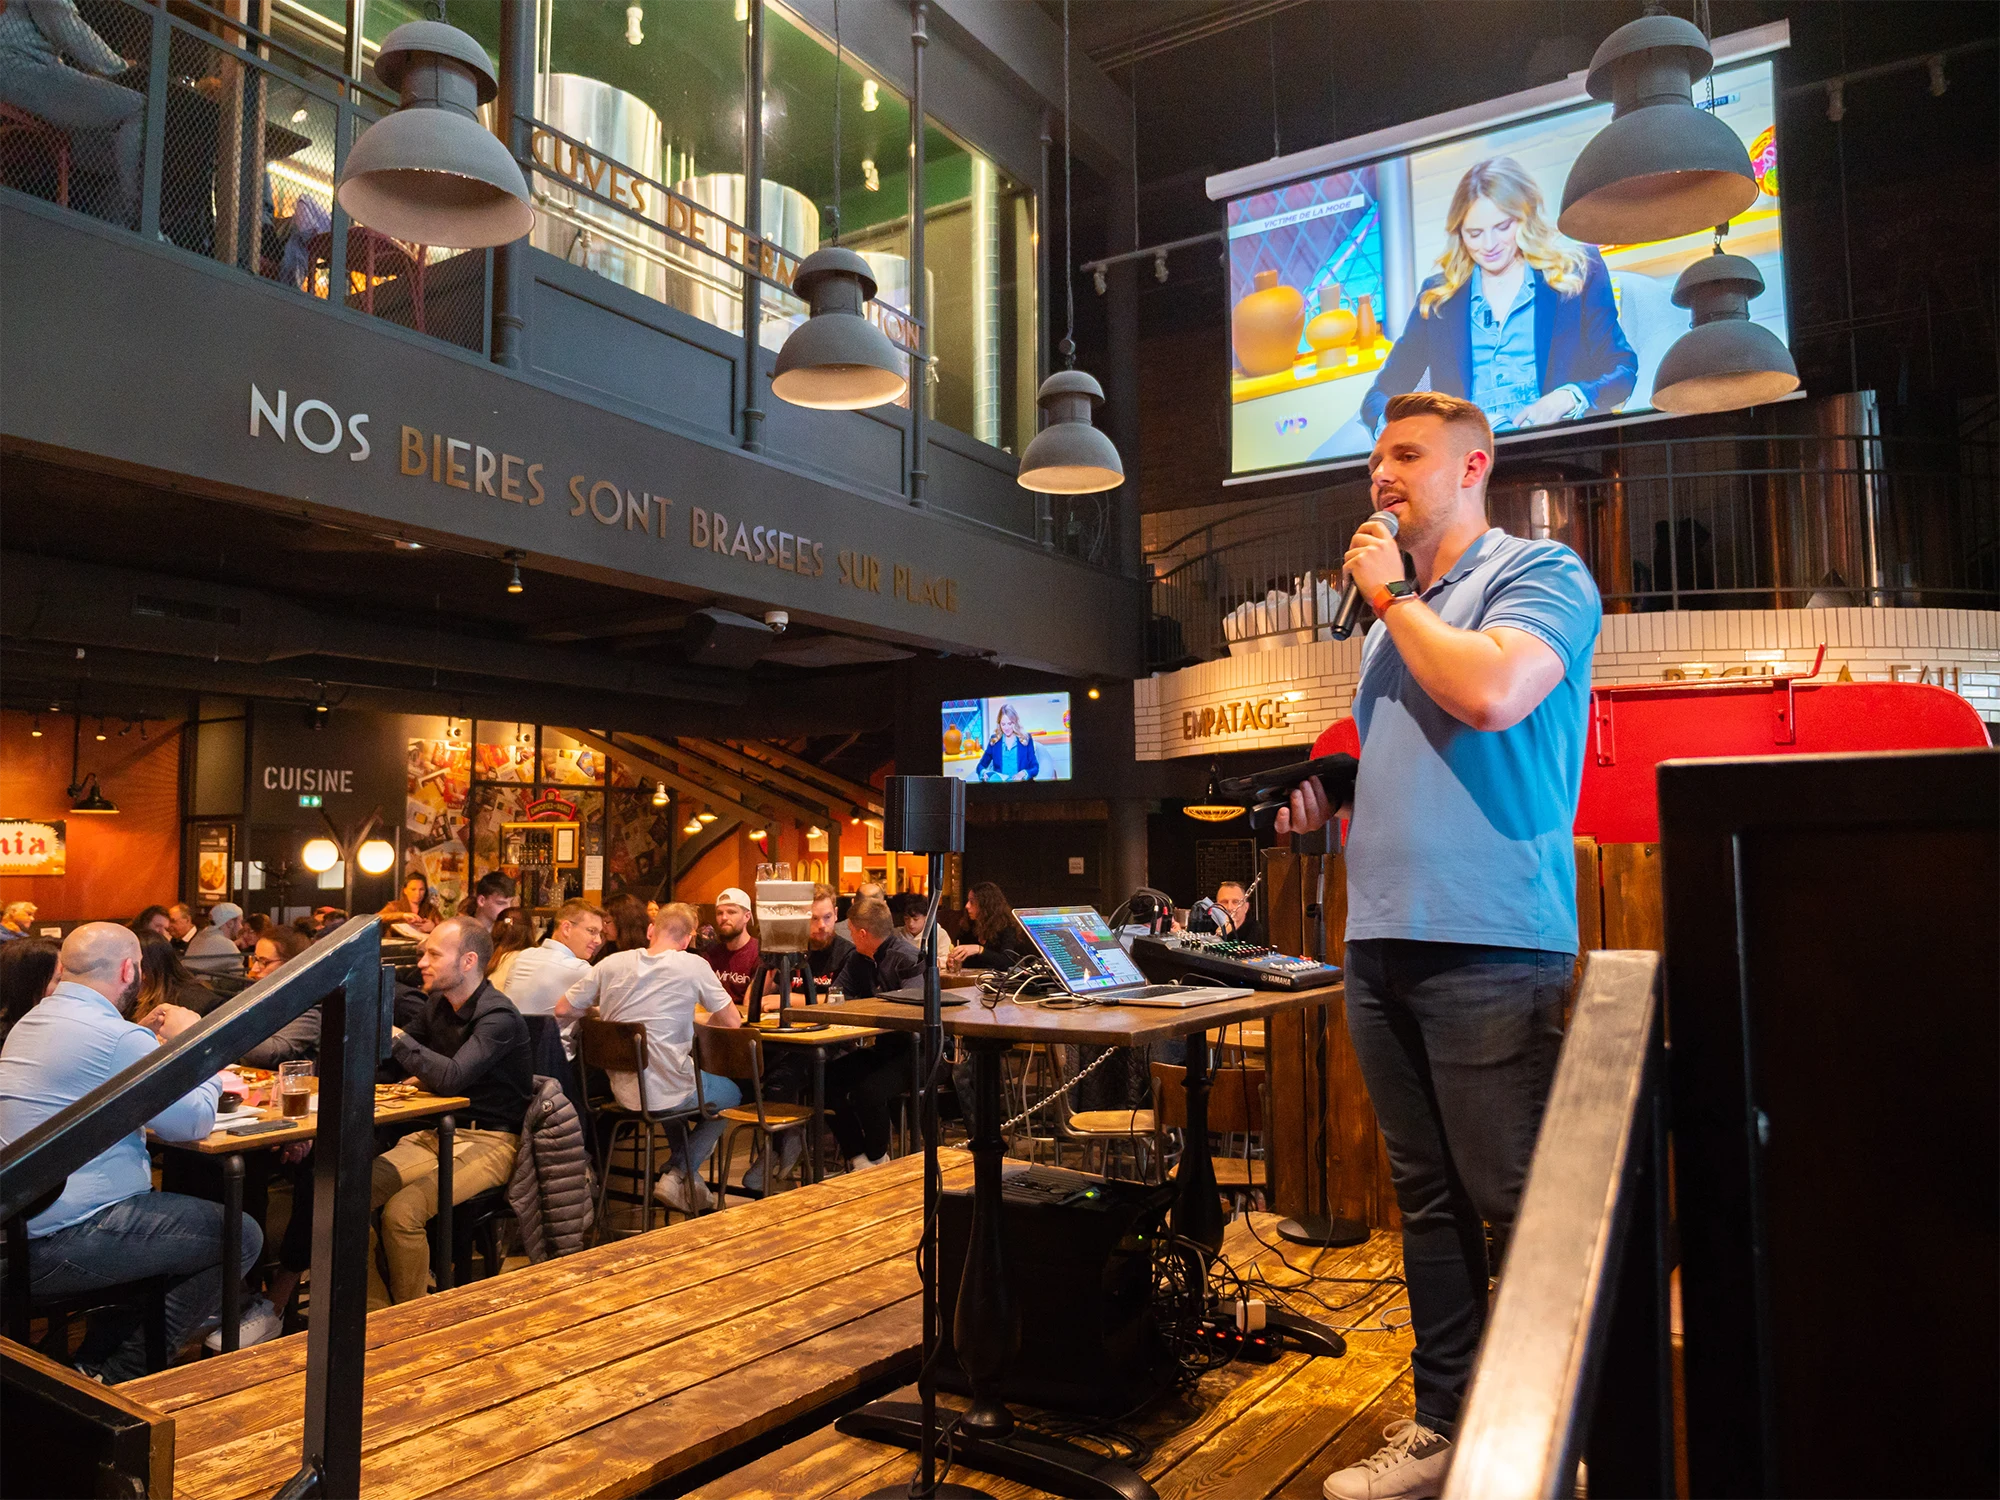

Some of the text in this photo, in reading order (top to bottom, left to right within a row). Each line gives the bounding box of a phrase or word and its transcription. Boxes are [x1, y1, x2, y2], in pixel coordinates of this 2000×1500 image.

[531, 129, 646, 214] CUVES
[667, 194, 708, 247] DE
[1264, 200, 1351, 229] VICTIME DE LA MODE
[1275, 417, 1308, 436] VIP
[249, 382, 960, 613] NOS BIERES SONT BRASSEES SUR PLACE
[1182, 697, 1290, 741] EMPATAGE
[263, 765, 354, 793] CUISINE
[1267, 974, 1292, 987] YAMAHA
